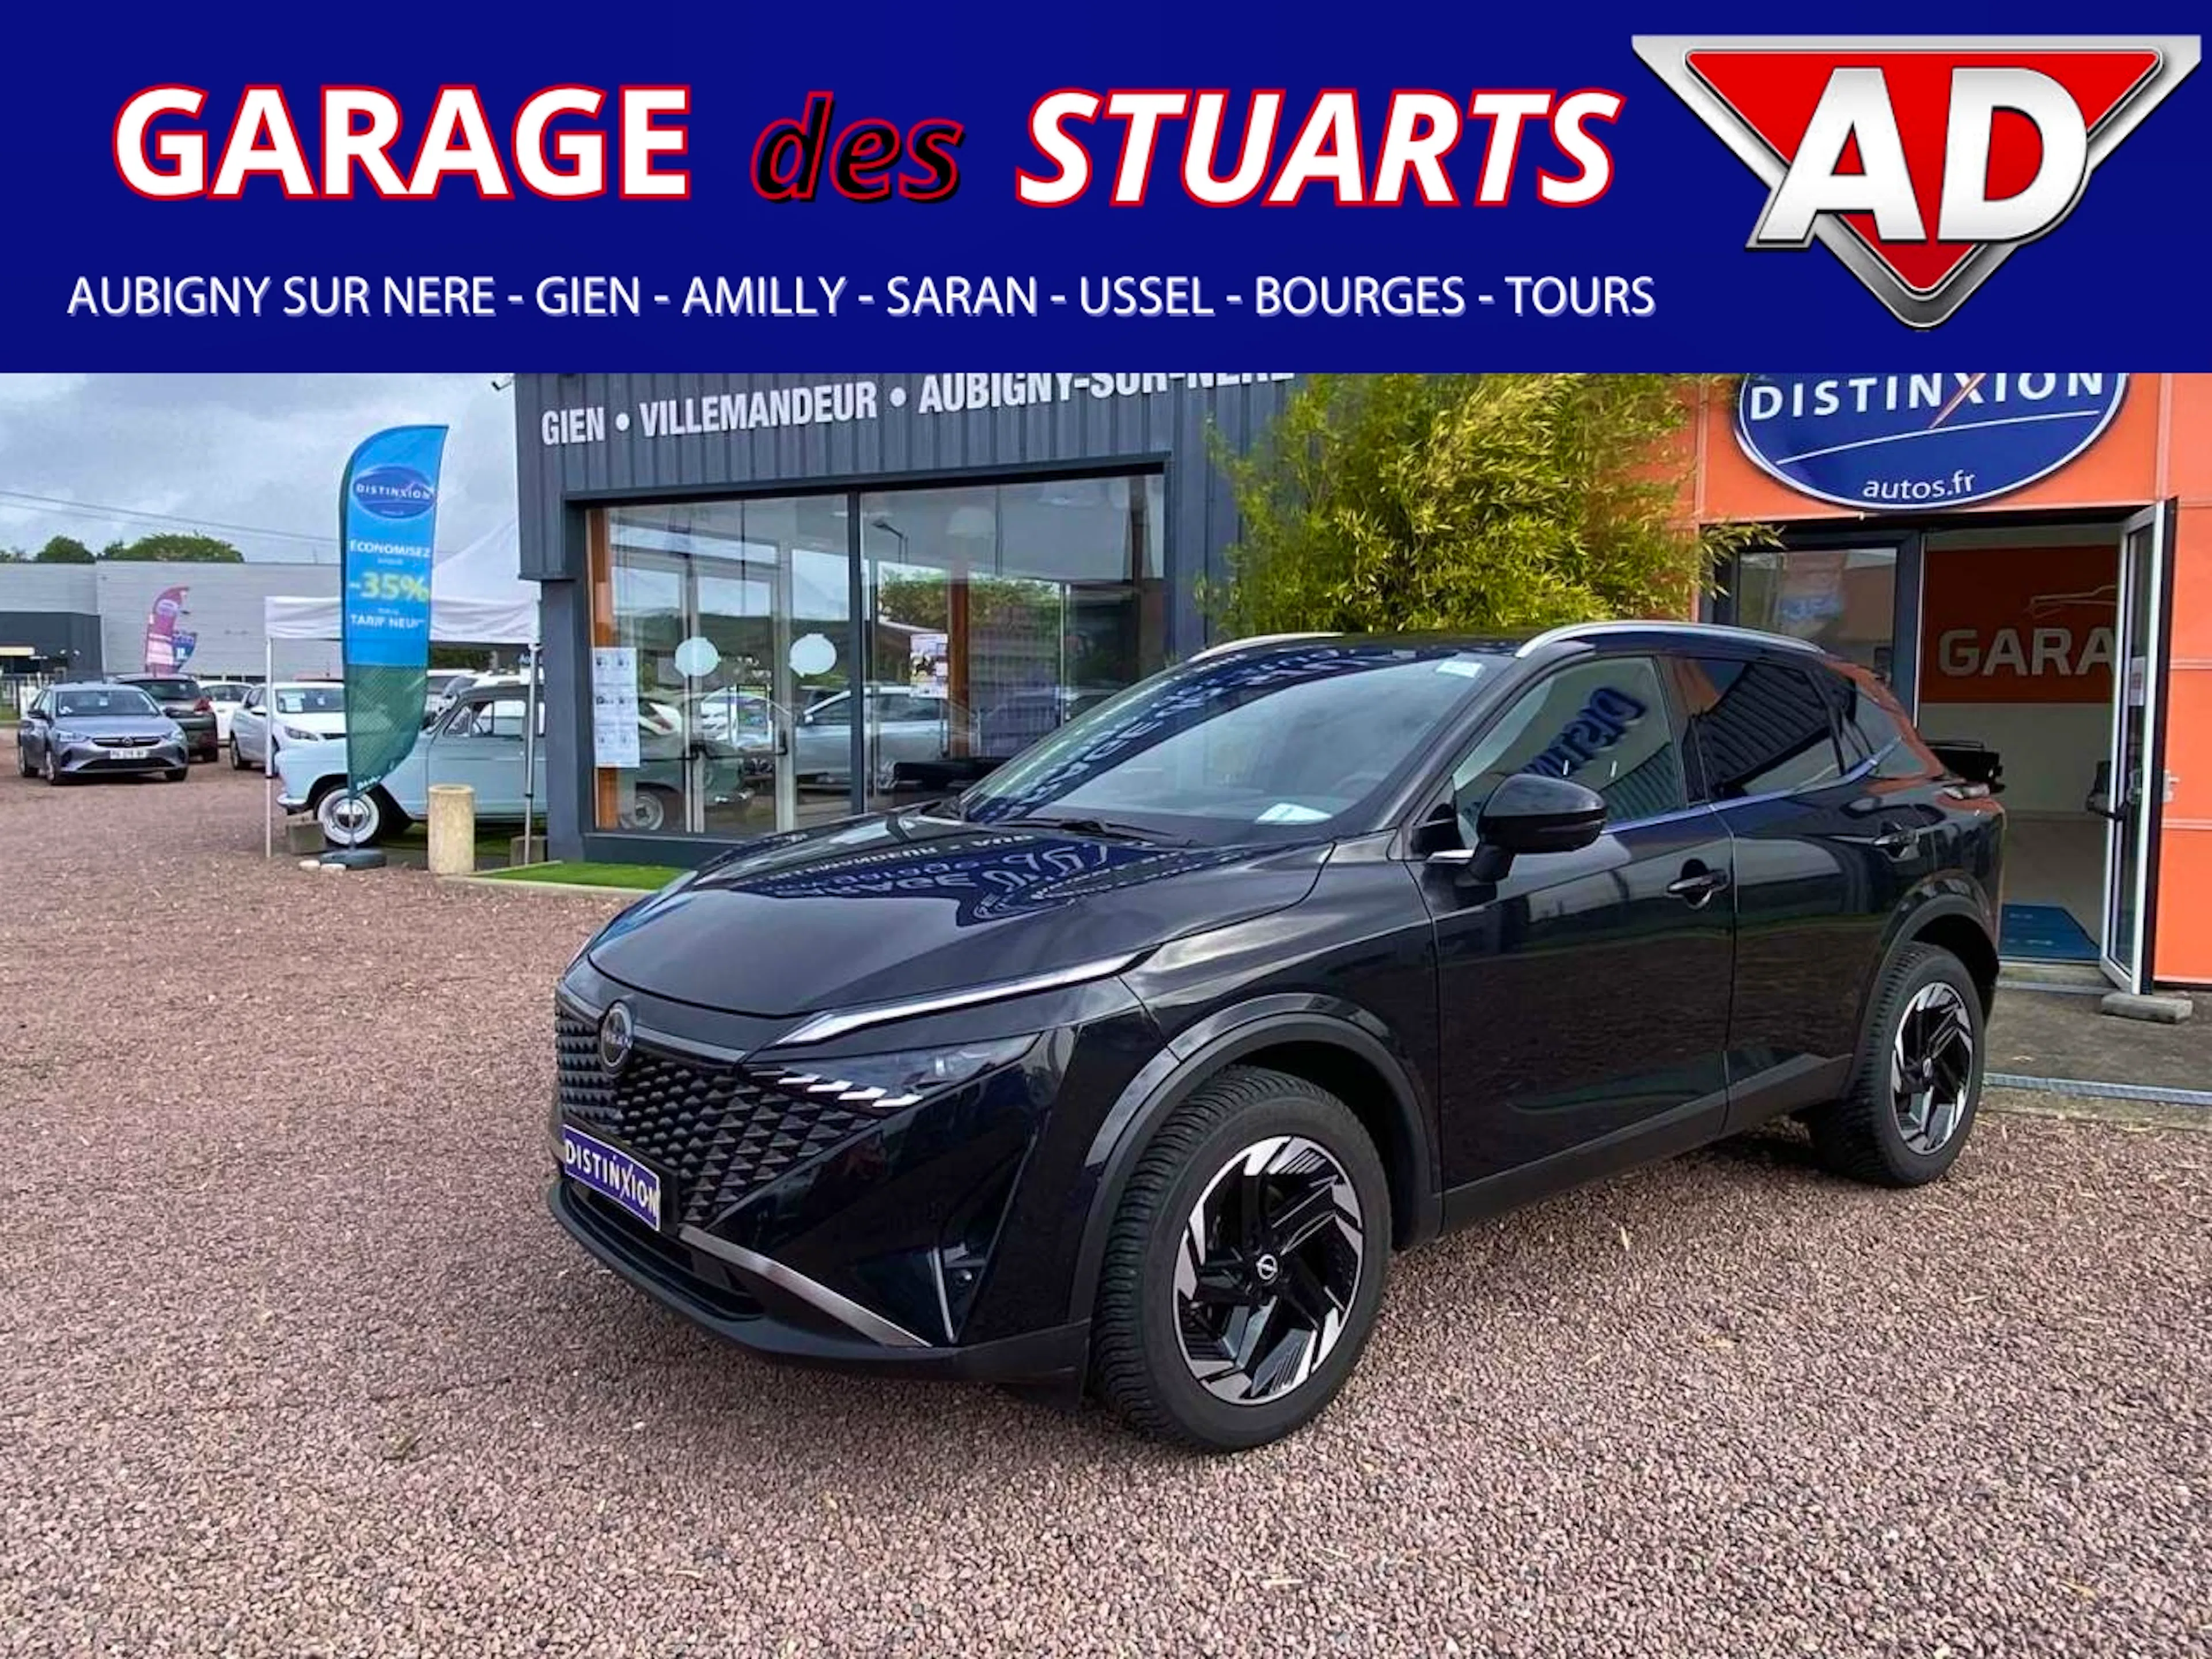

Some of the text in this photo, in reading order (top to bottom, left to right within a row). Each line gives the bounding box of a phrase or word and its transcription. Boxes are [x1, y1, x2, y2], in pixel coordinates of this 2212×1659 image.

[541, 407, 604, 445] GIEN
[639, 381, 877, 437] VILLEMANDEUR
[1750, 373, 2103, 425] DISTINXION
[356, 483, 431, 500] DISTINXION
[1862, 469, 1976, 499] autos.fr
[349, 571, 430, 603] -35%
[564, 1139, 661, 1217] DISTINXION
